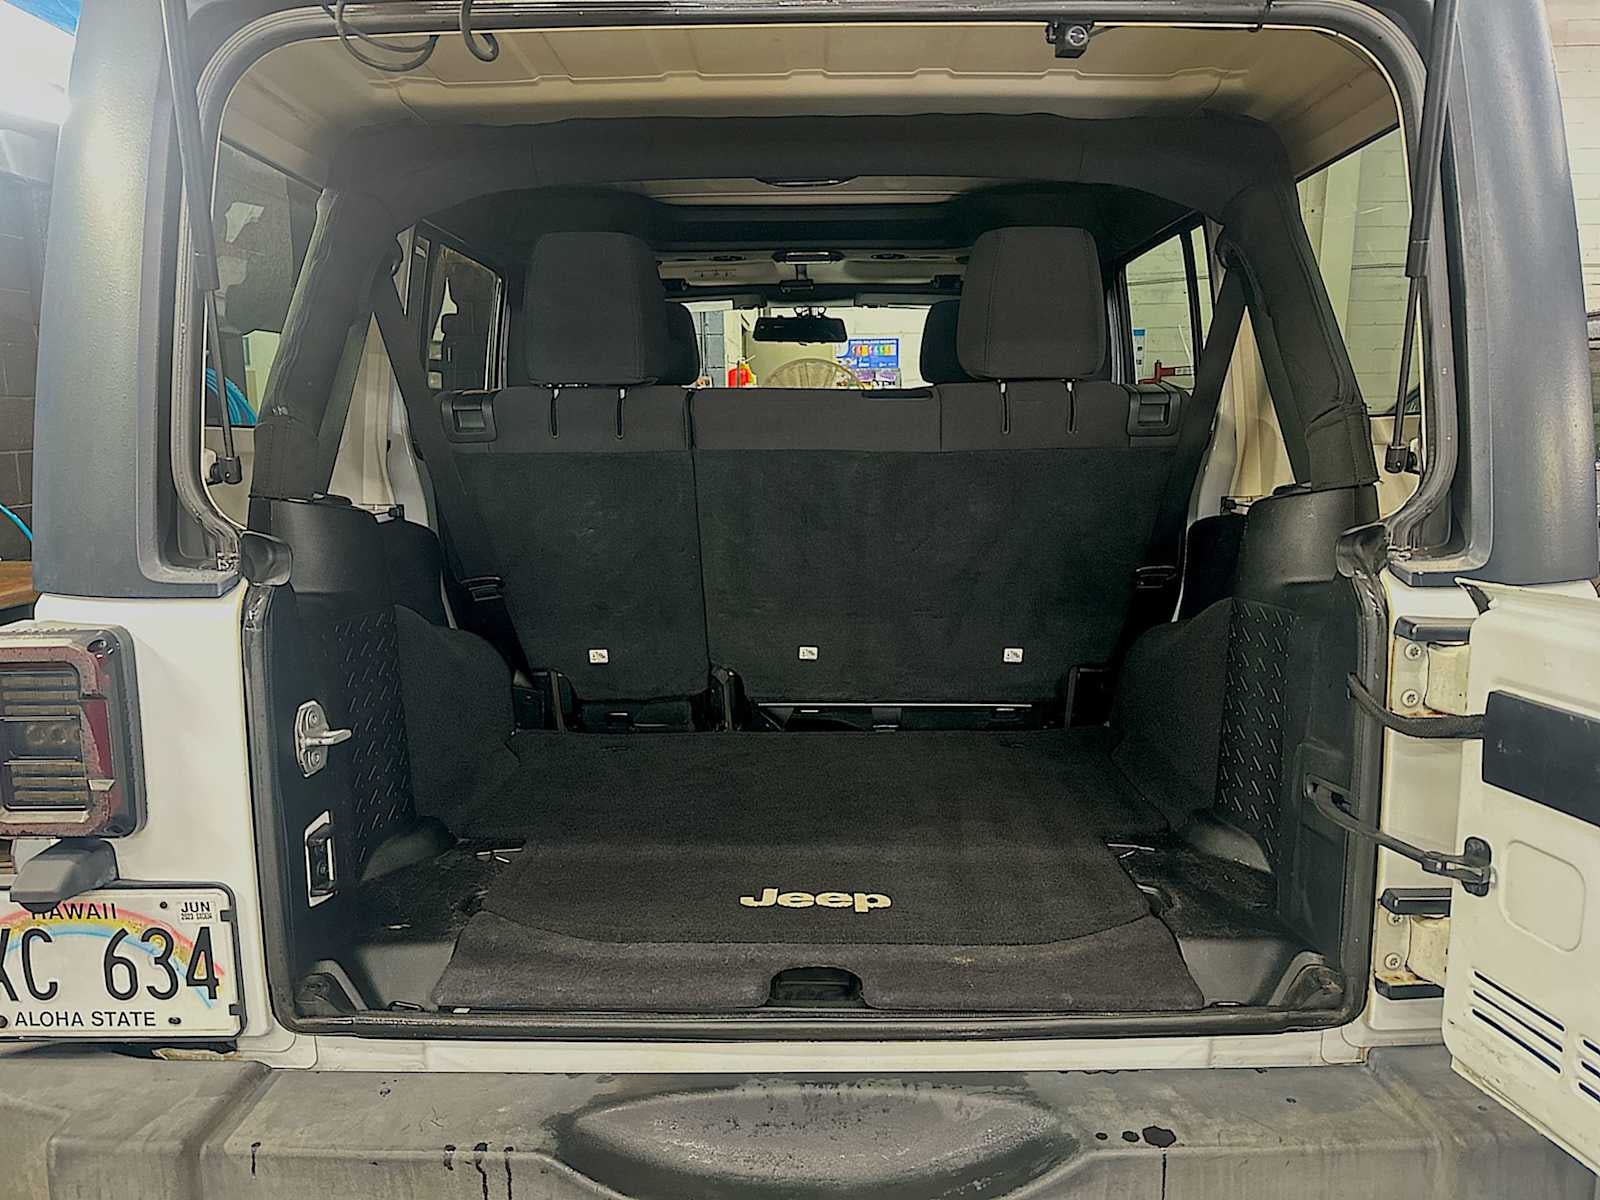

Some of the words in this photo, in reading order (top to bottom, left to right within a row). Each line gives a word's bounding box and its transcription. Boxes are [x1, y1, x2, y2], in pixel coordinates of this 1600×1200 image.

[181, 901, 210, 912] JUN
[740, 887, 893, 913] Jeep
[104, 926, 219, 1001] 634
[15, 1011, 84, 1027] ALOHA
[91, 1011, 156, 1027] STATE
